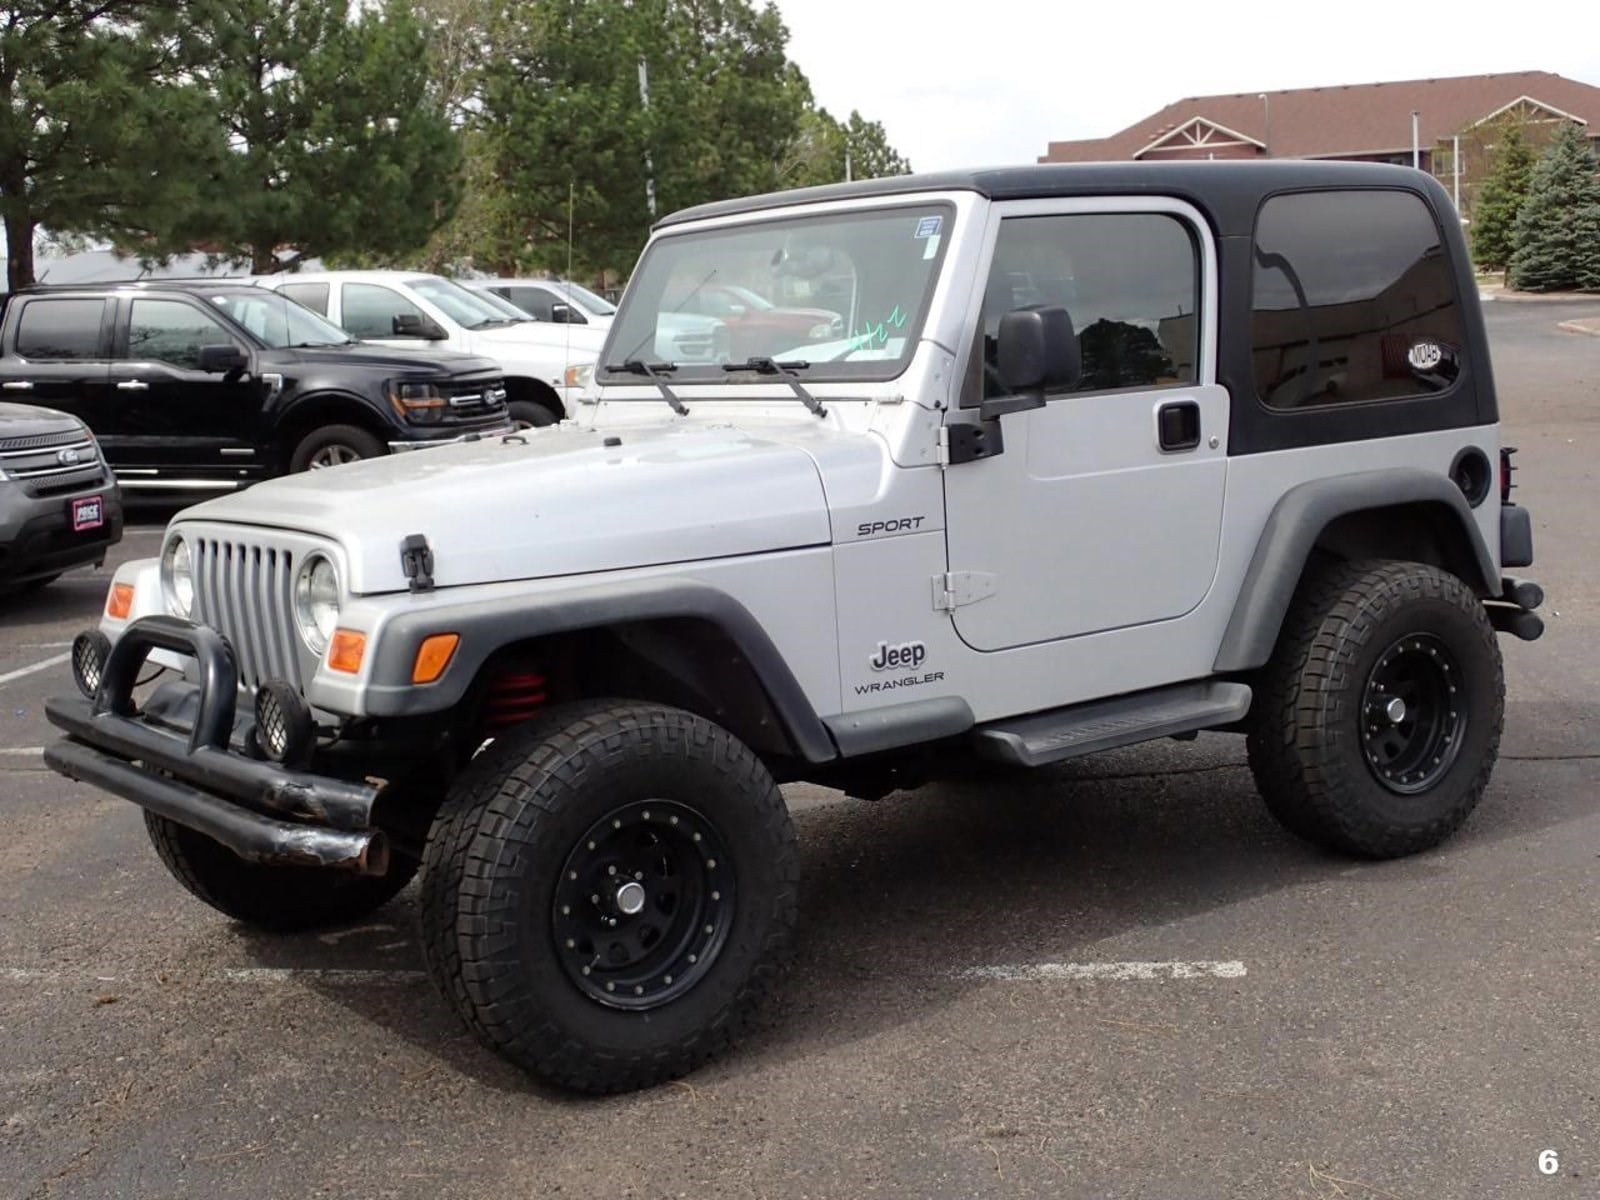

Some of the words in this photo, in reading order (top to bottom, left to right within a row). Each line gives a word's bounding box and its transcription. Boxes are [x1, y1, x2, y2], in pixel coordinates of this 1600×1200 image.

[1413, 344, 1438, 364] MOAB
[857, 516, 925, 536] SPORT
[872, 642, 926, 670] Jeep
[854, 671, 945, 695] WRANGLER
